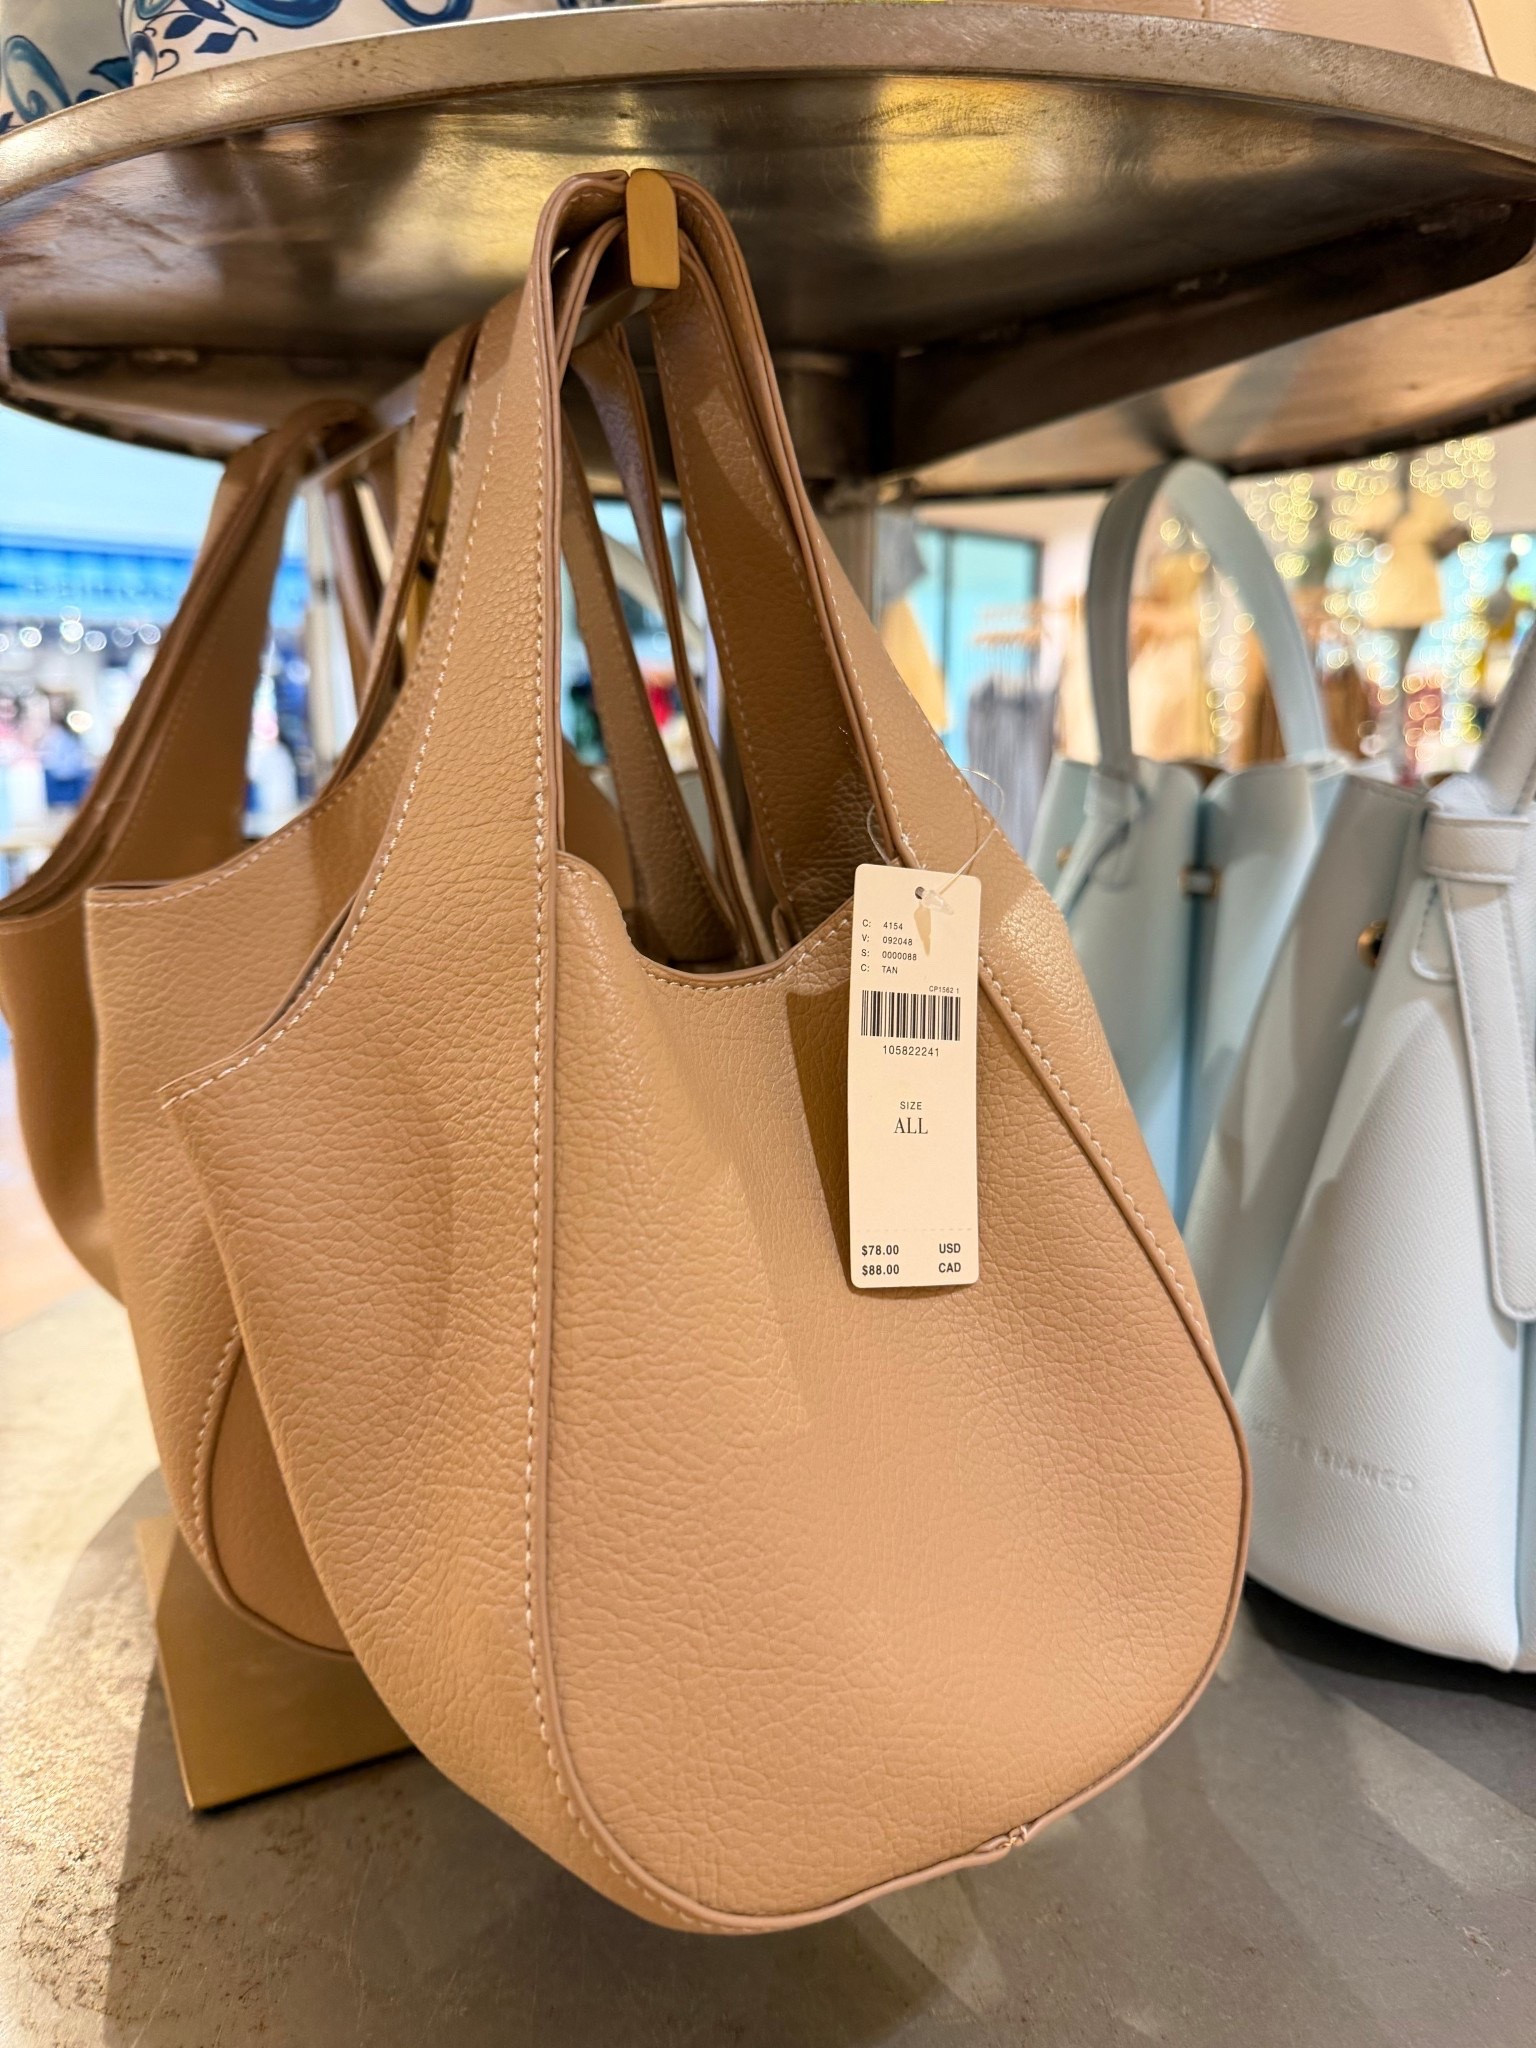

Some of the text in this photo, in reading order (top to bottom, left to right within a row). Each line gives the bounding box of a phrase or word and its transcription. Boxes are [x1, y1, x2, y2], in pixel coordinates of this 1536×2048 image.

[862, 918, 903, 930] C: 4154
[861, 934, 913, 946] V: 092048
[861, 948, 917, 961] S: 0000088
[860, 964, 898, 974] C: TAN
[882, 1045, 940, 1057] 105822241
[899, 1101, 923, 1111] SIZE
[894, 1117, 929, 1135] ALL
[861, 1243, 961, 1257] $78.00 USD
[861, 1262, 962, 1276] $88.00 CAD
